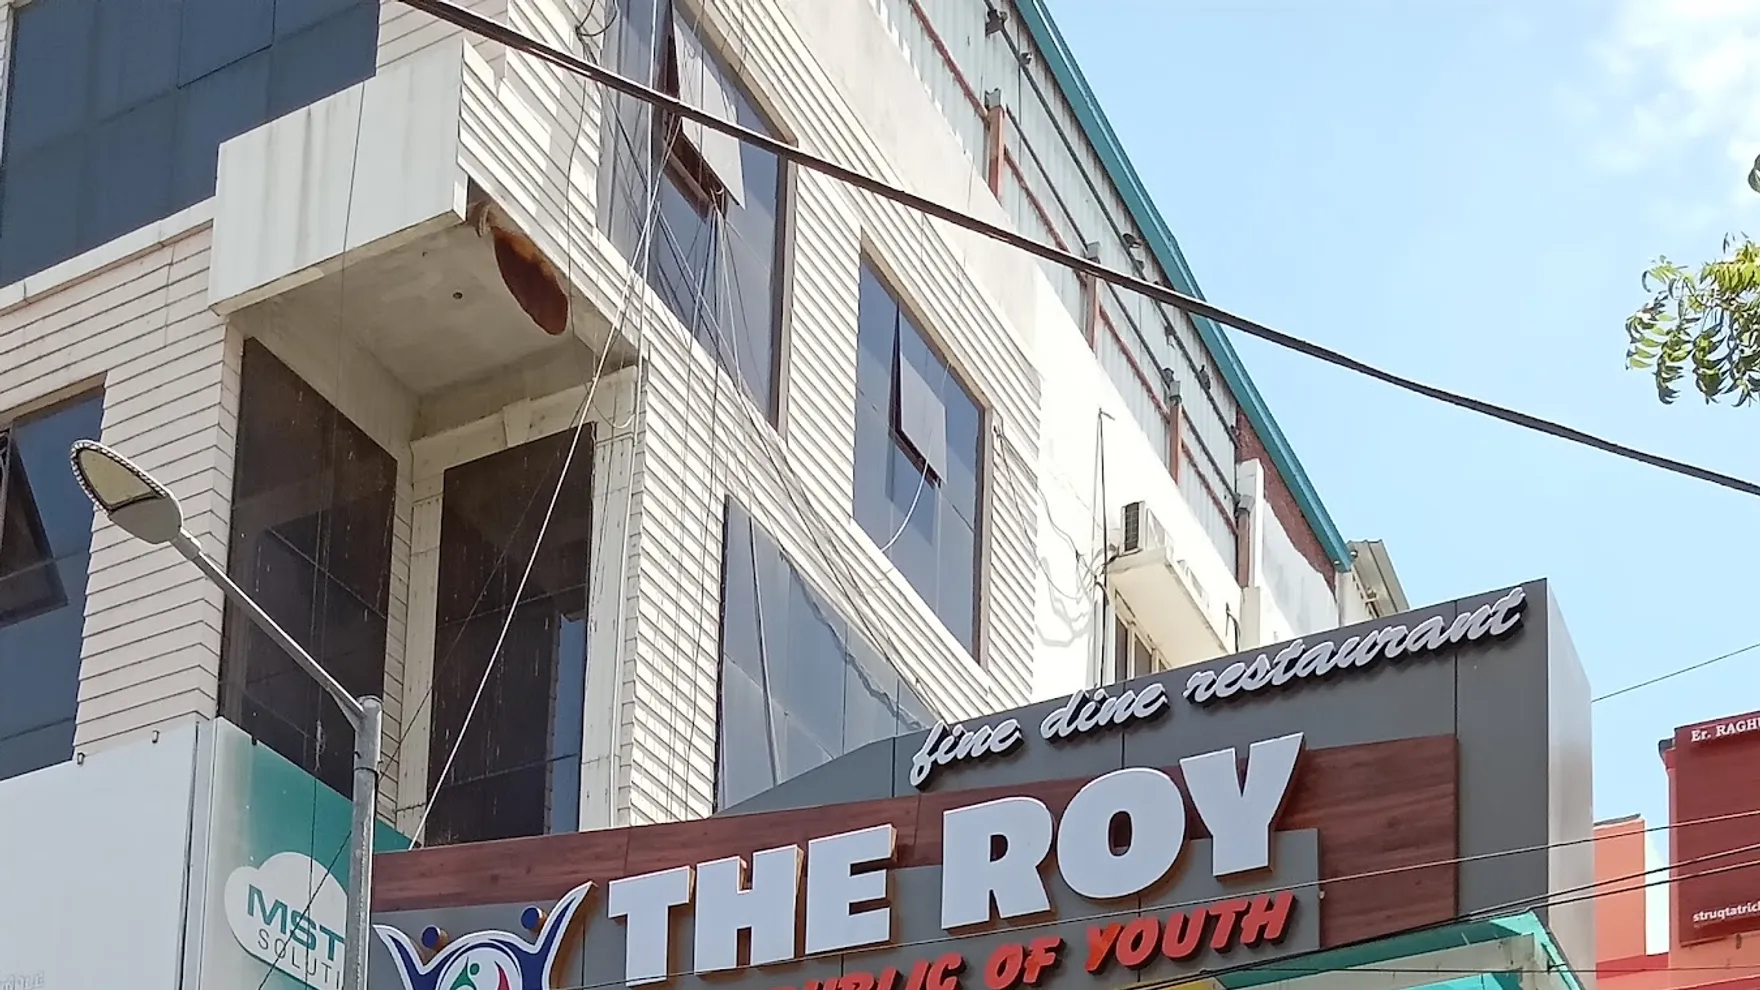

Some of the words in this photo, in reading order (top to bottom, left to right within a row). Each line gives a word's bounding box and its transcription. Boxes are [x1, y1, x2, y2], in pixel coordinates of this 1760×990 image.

[909, 718, 1024, 788] fine
[1039, 688, 1169, 740] dine
[1182, 586, 1526, 703] restaurant
[1691, 729, 1711, 742] Er.
[1715, 717, 1760, 737] RAGH
[607, 823, 897, 987] THE
[940, 731, 1306, 932] ROY
[247, 883, 346, 962] MST
[983, 935, 1063, 990] OF
[1084, 889, 1295, 973] YOUTH
